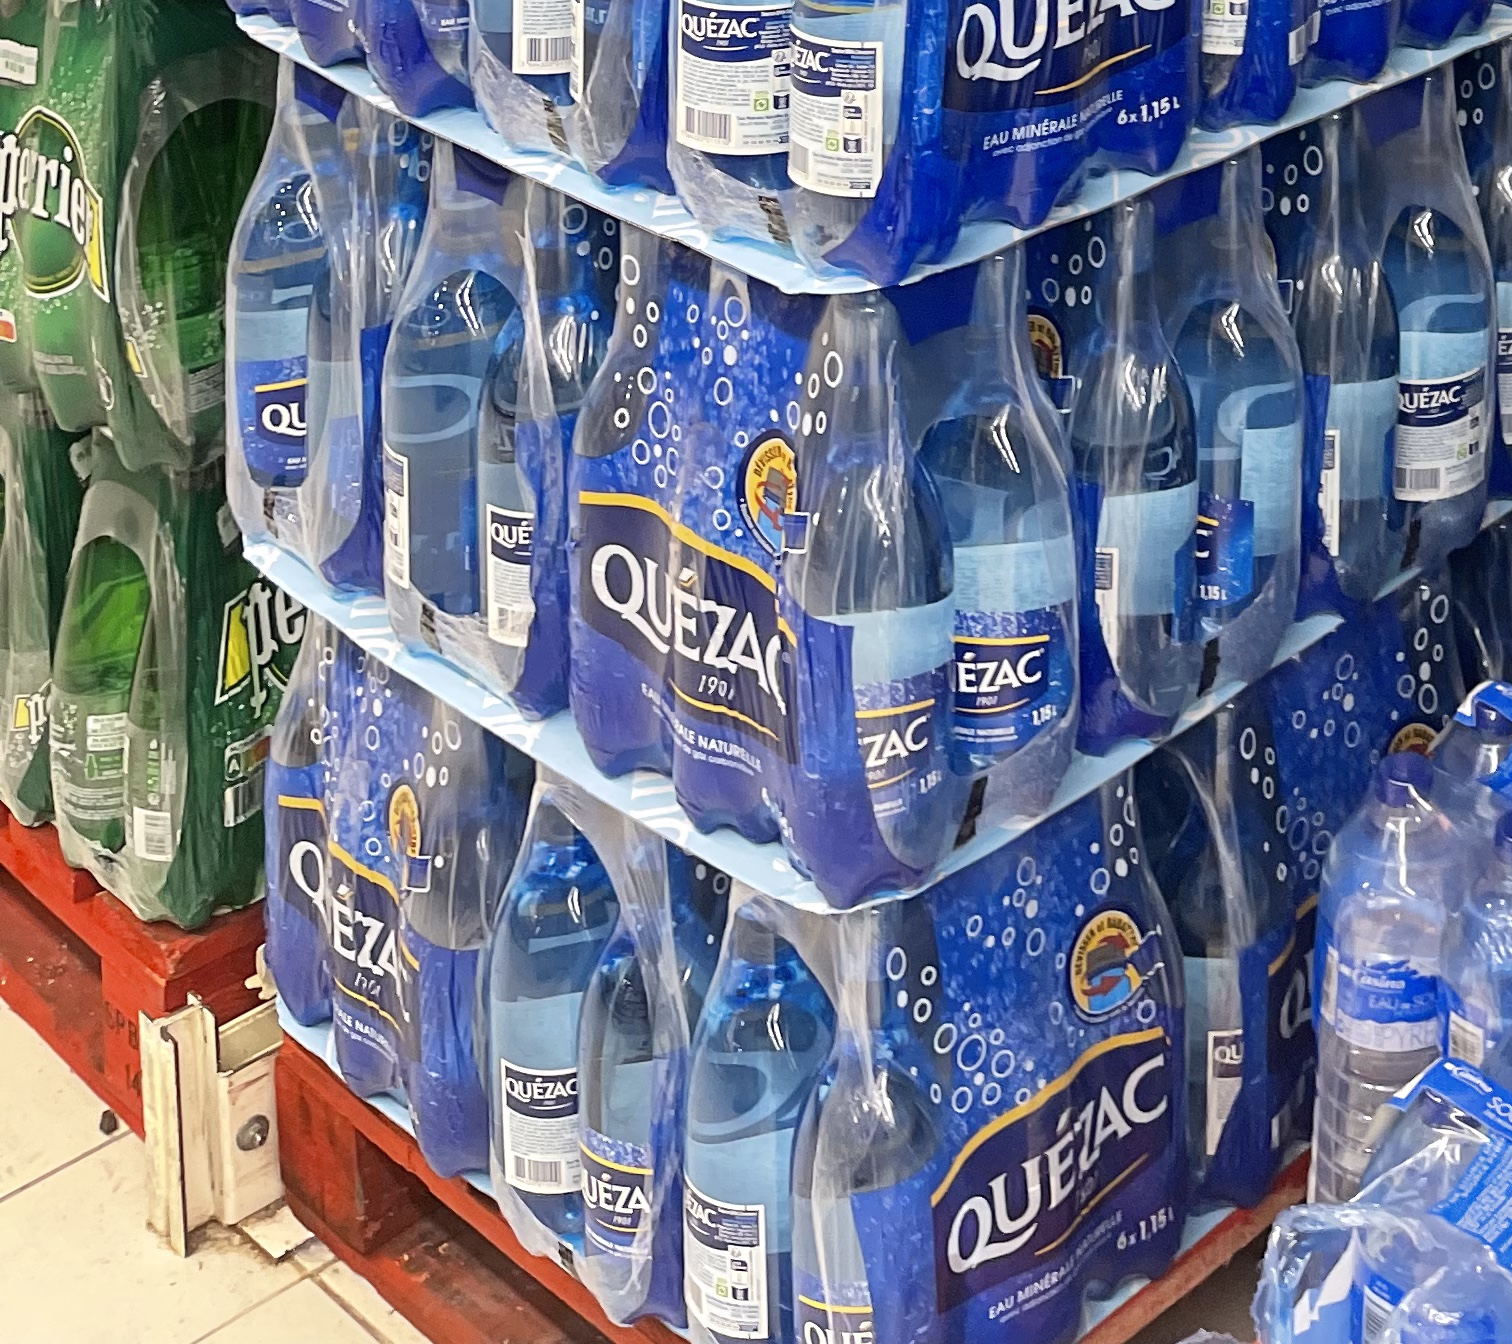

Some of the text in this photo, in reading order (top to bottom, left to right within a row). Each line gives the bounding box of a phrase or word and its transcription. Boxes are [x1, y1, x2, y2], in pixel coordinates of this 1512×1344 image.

[681, 12, 759, 43] QUÉZAC
[983, 130, 1009, 152] EAU
[1011, 113, 1078, 142] MINÉRALE
[1398, 379, 1464, 413] QUÉZAC
[946, 1052, 1170, 1276] QUÉZAC
[987, 1294, 1015, 1321] EAU
